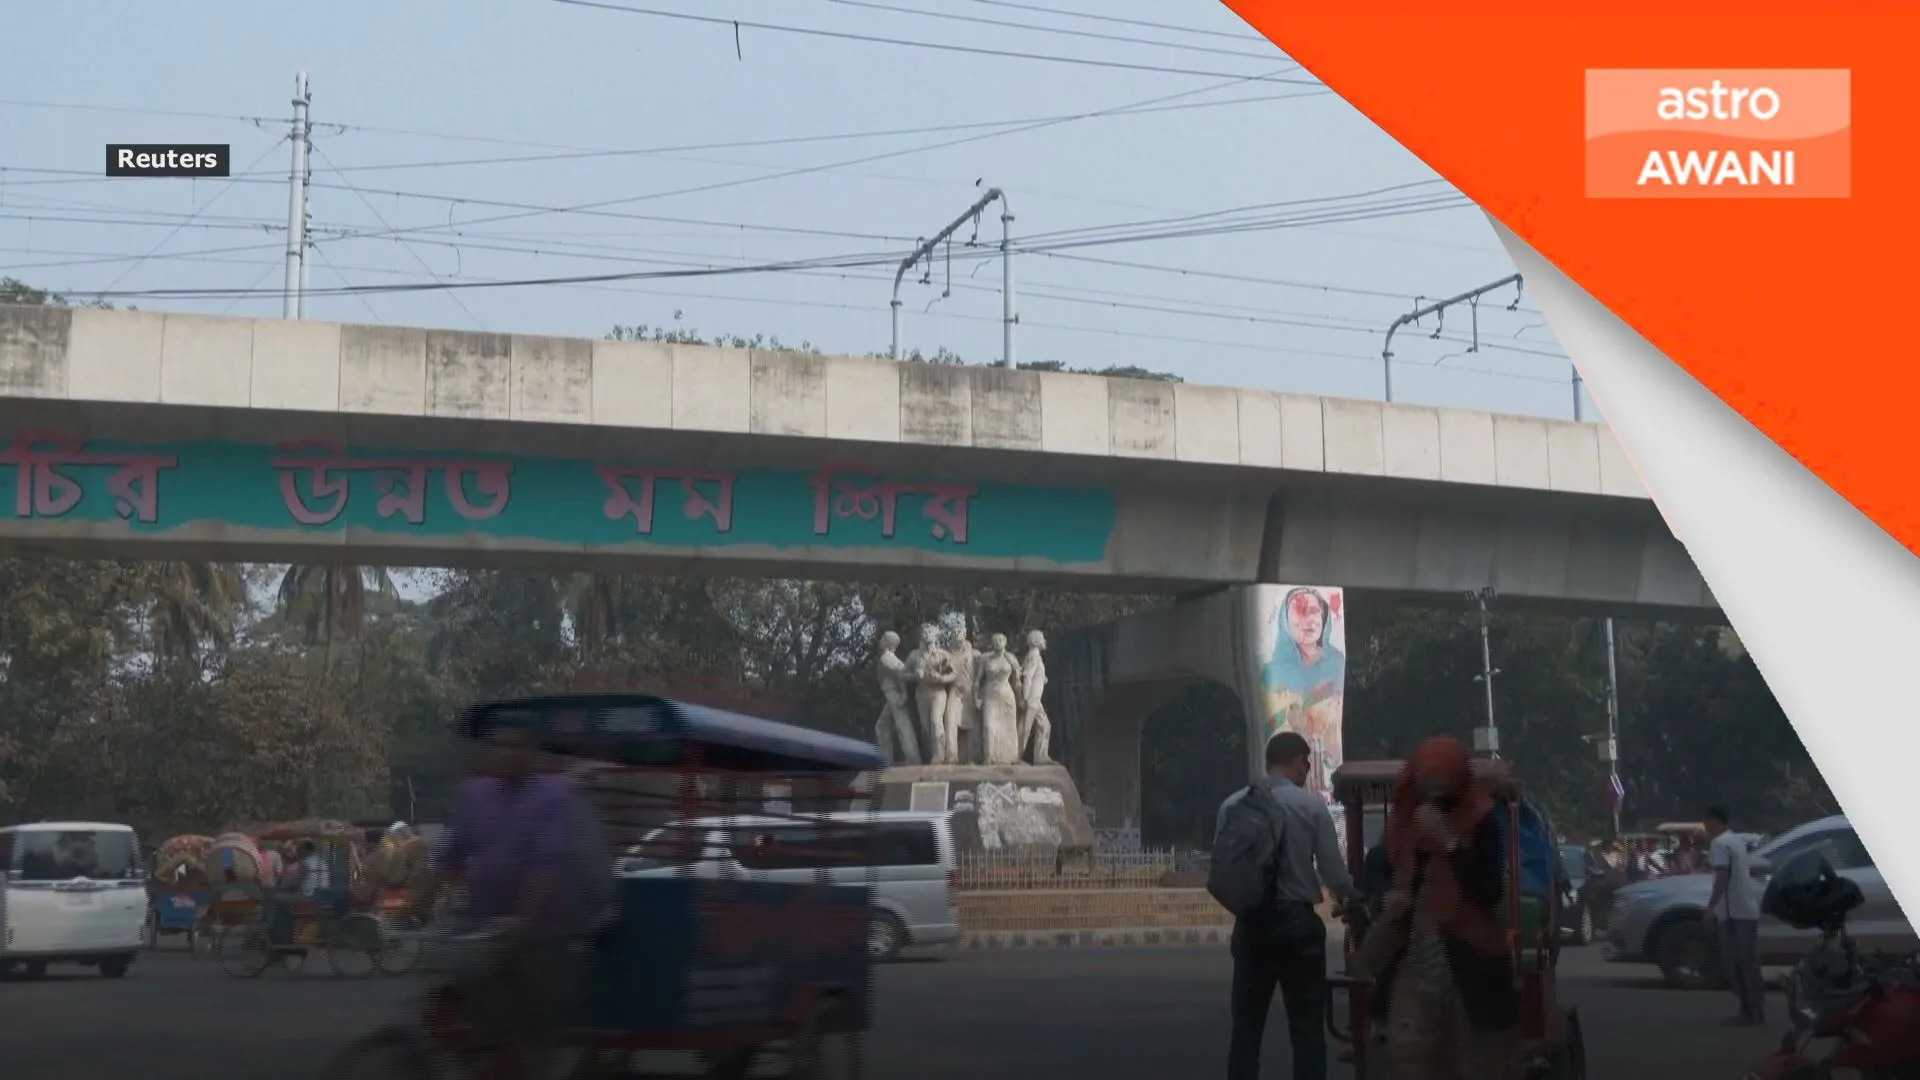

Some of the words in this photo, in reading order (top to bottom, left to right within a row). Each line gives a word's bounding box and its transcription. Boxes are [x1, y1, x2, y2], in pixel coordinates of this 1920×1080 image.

[0, 427, 179, 524] চির
[271, 438, 515, 525] উন্নত
[596, 464, 737, 535] মম
[808, 460, 979, 544] শির
